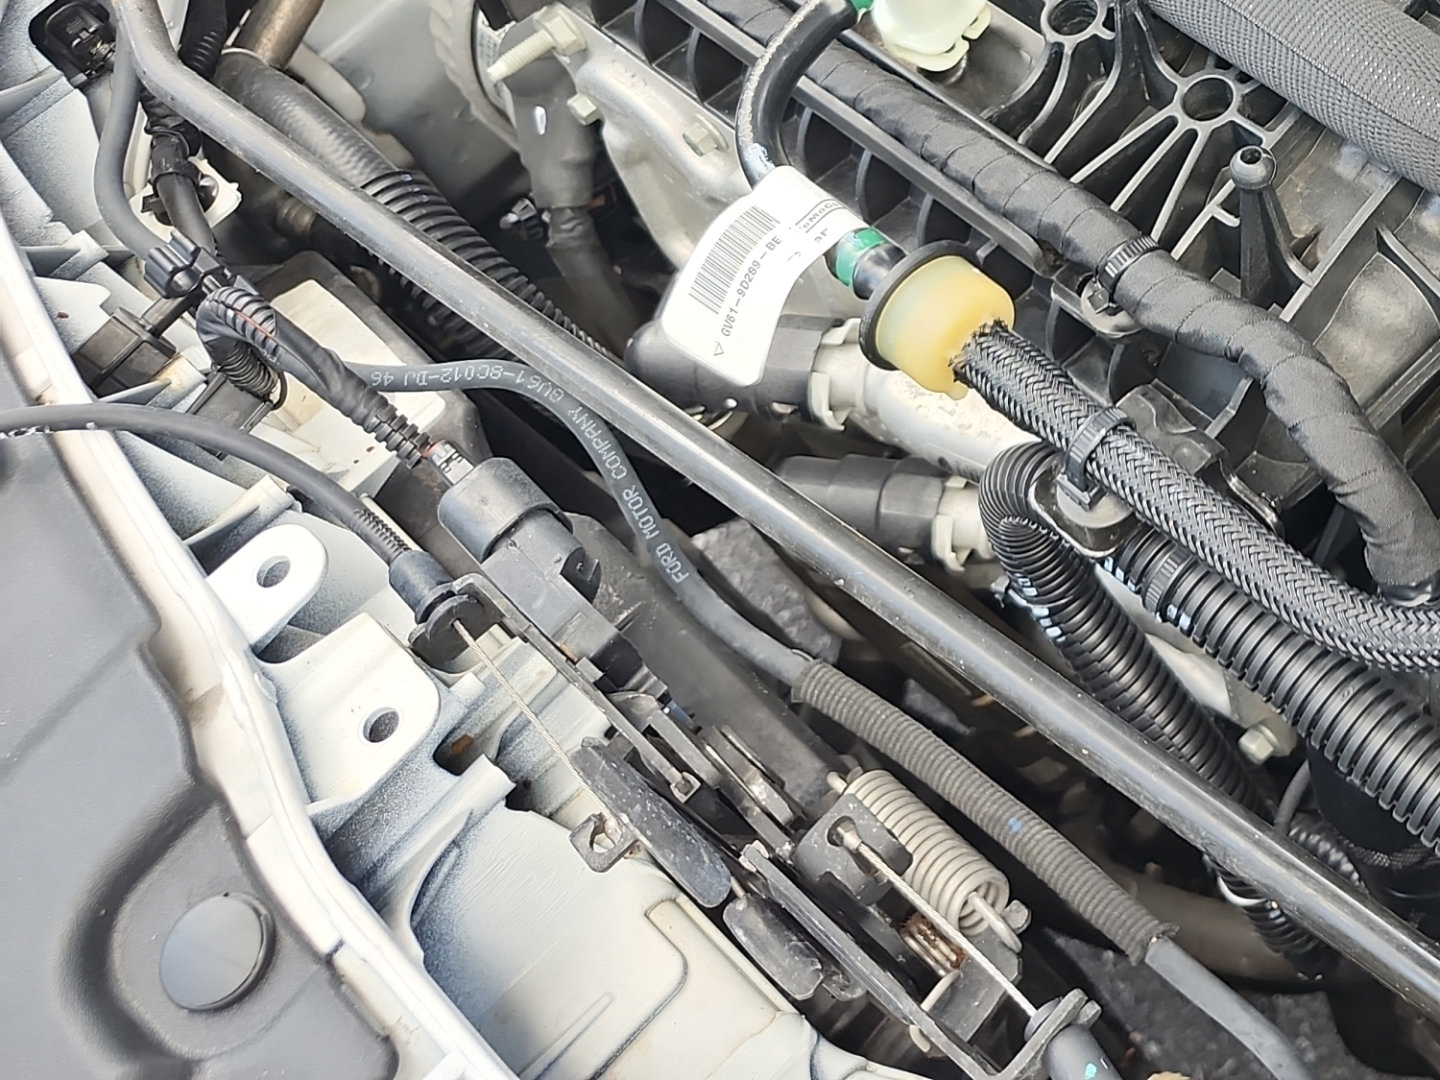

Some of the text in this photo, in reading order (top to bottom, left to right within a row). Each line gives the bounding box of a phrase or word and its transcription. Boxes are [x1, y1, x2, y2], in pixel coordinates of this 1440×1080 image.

[568, 405, 627, 481] COMPANY
[621, 484, 661, 541] MOTOR
[655, 542, 690, 584] FORD
